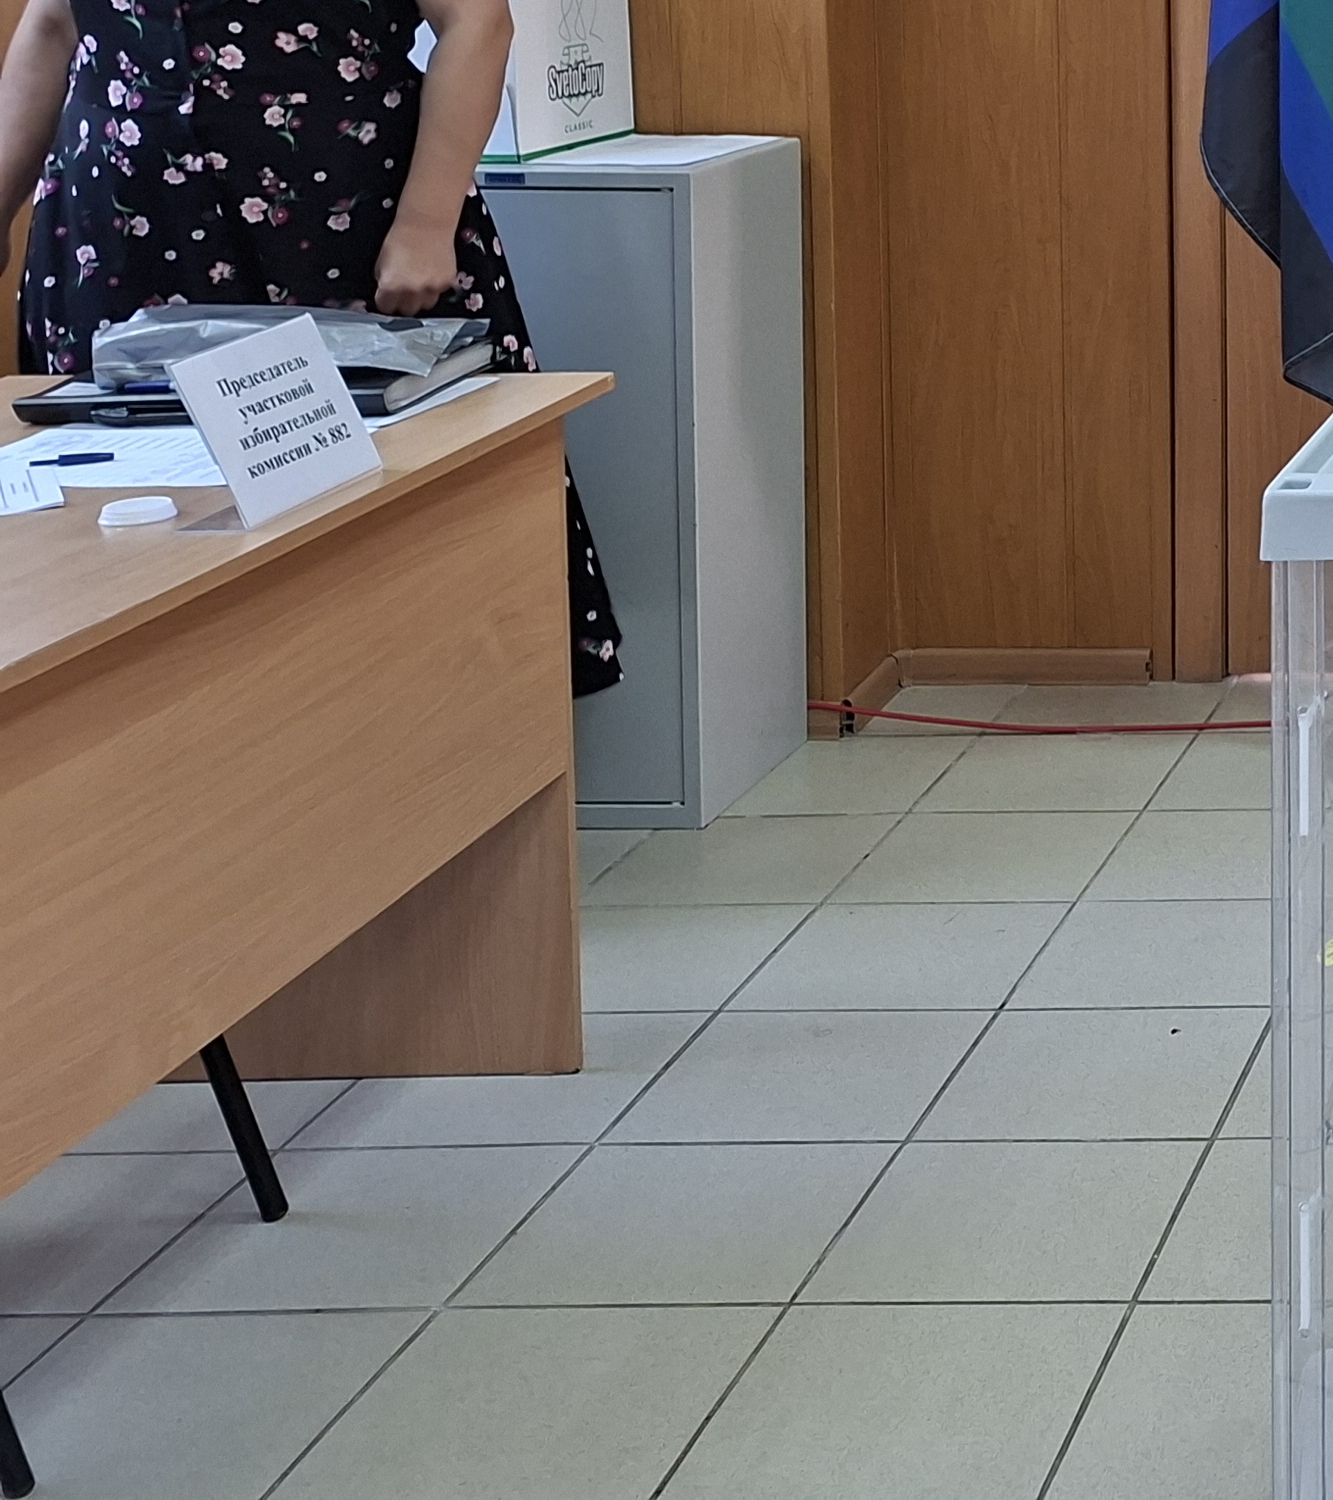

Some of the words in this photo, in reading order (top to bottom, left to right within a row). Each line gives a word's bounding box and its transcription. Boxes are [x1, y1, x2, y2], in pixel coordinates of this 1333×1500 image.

[547, 61, 605, 102] SvetoCopy
[563, 119, 594, 134] CLASSIC
[216, 354, 310, 399] Председатель
[237, 378, 316, 426] участковой
[237, 398, 338, 452] избирательной
[245, 441, 313, 480] комиссии
[313, 433, 331, 454] №
[328, 421, 353, 446] 882
